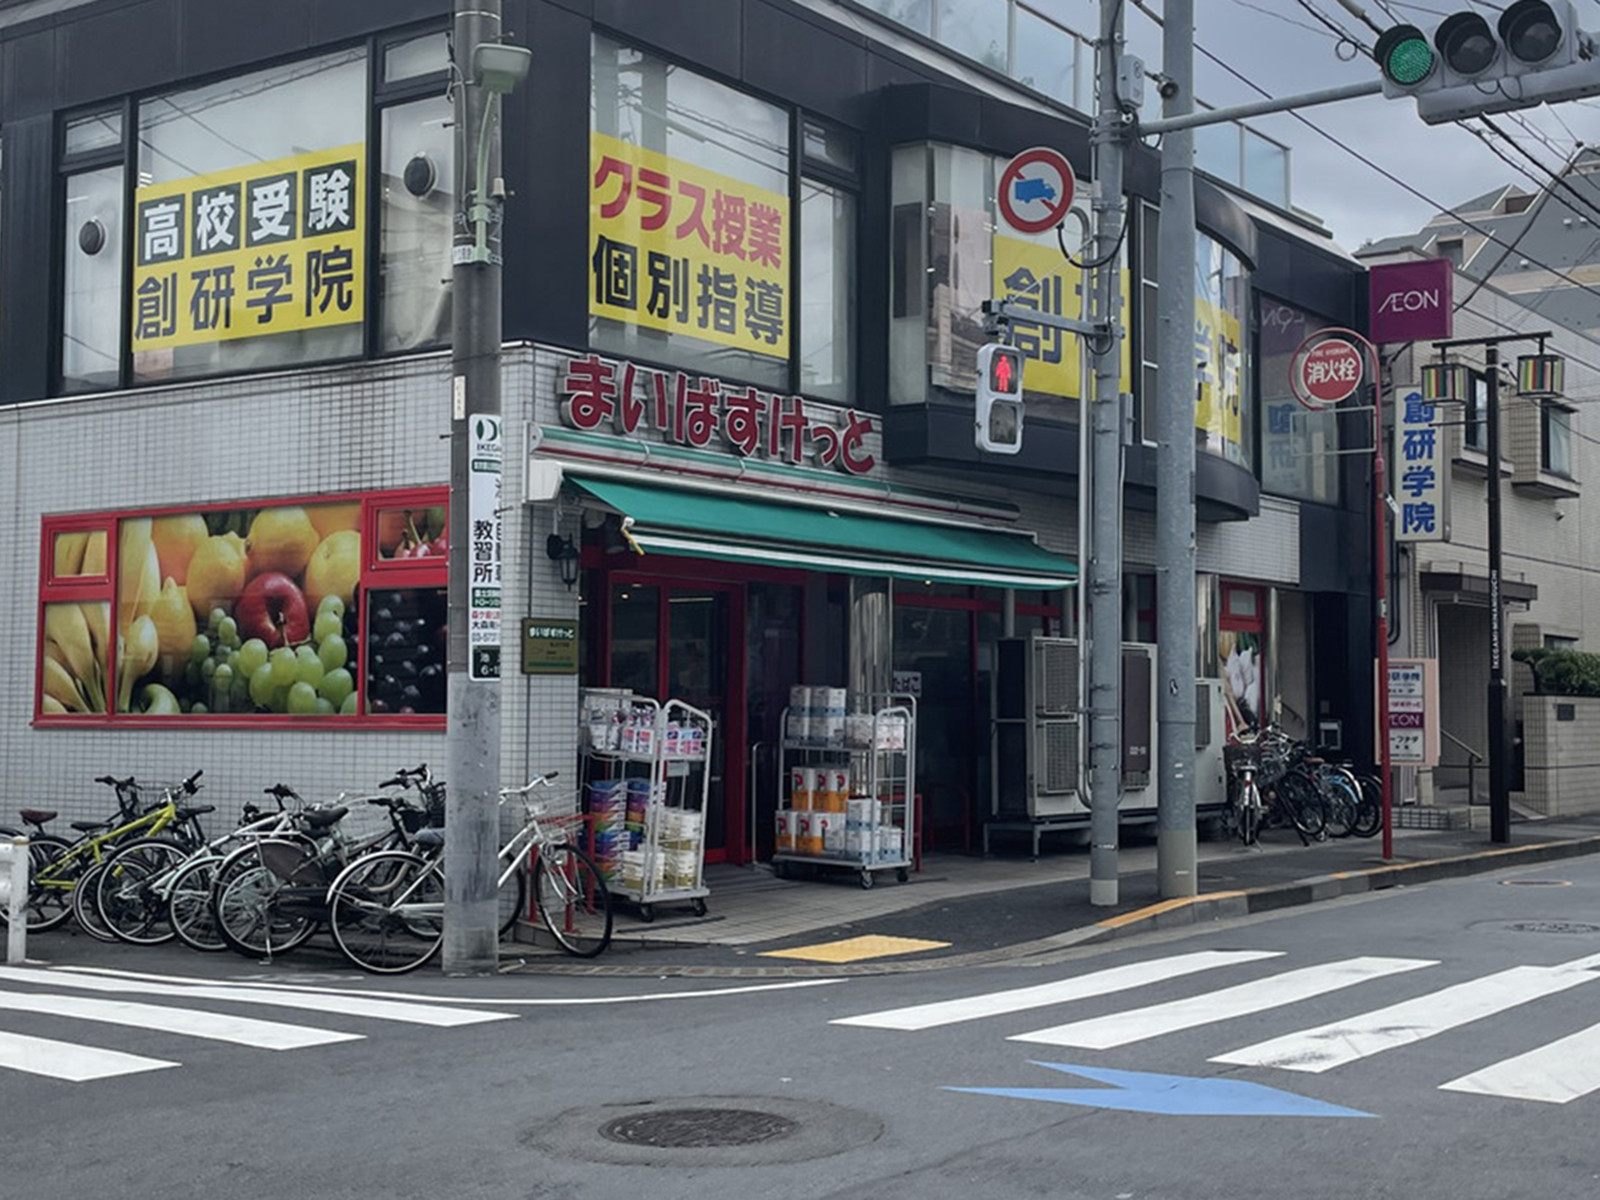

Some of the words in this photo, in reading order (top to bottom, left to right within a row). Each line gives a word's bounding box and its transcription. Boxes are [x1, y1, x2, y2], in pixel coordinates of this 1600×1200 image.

[144, 168, 351, 261] 高校受験
[595, 155, 783, 270] クラス授業
[134, 245, 354, 340] 創研学院
[592, 234, 784, 346] 個別指導
[562, 354, 876, 474] まいばすけっと
[1307, 357, 1358, 385] 消火栓
[1402, 391, 1436, 535] 創研学院
[473, 520, 493, 583] 教習所
